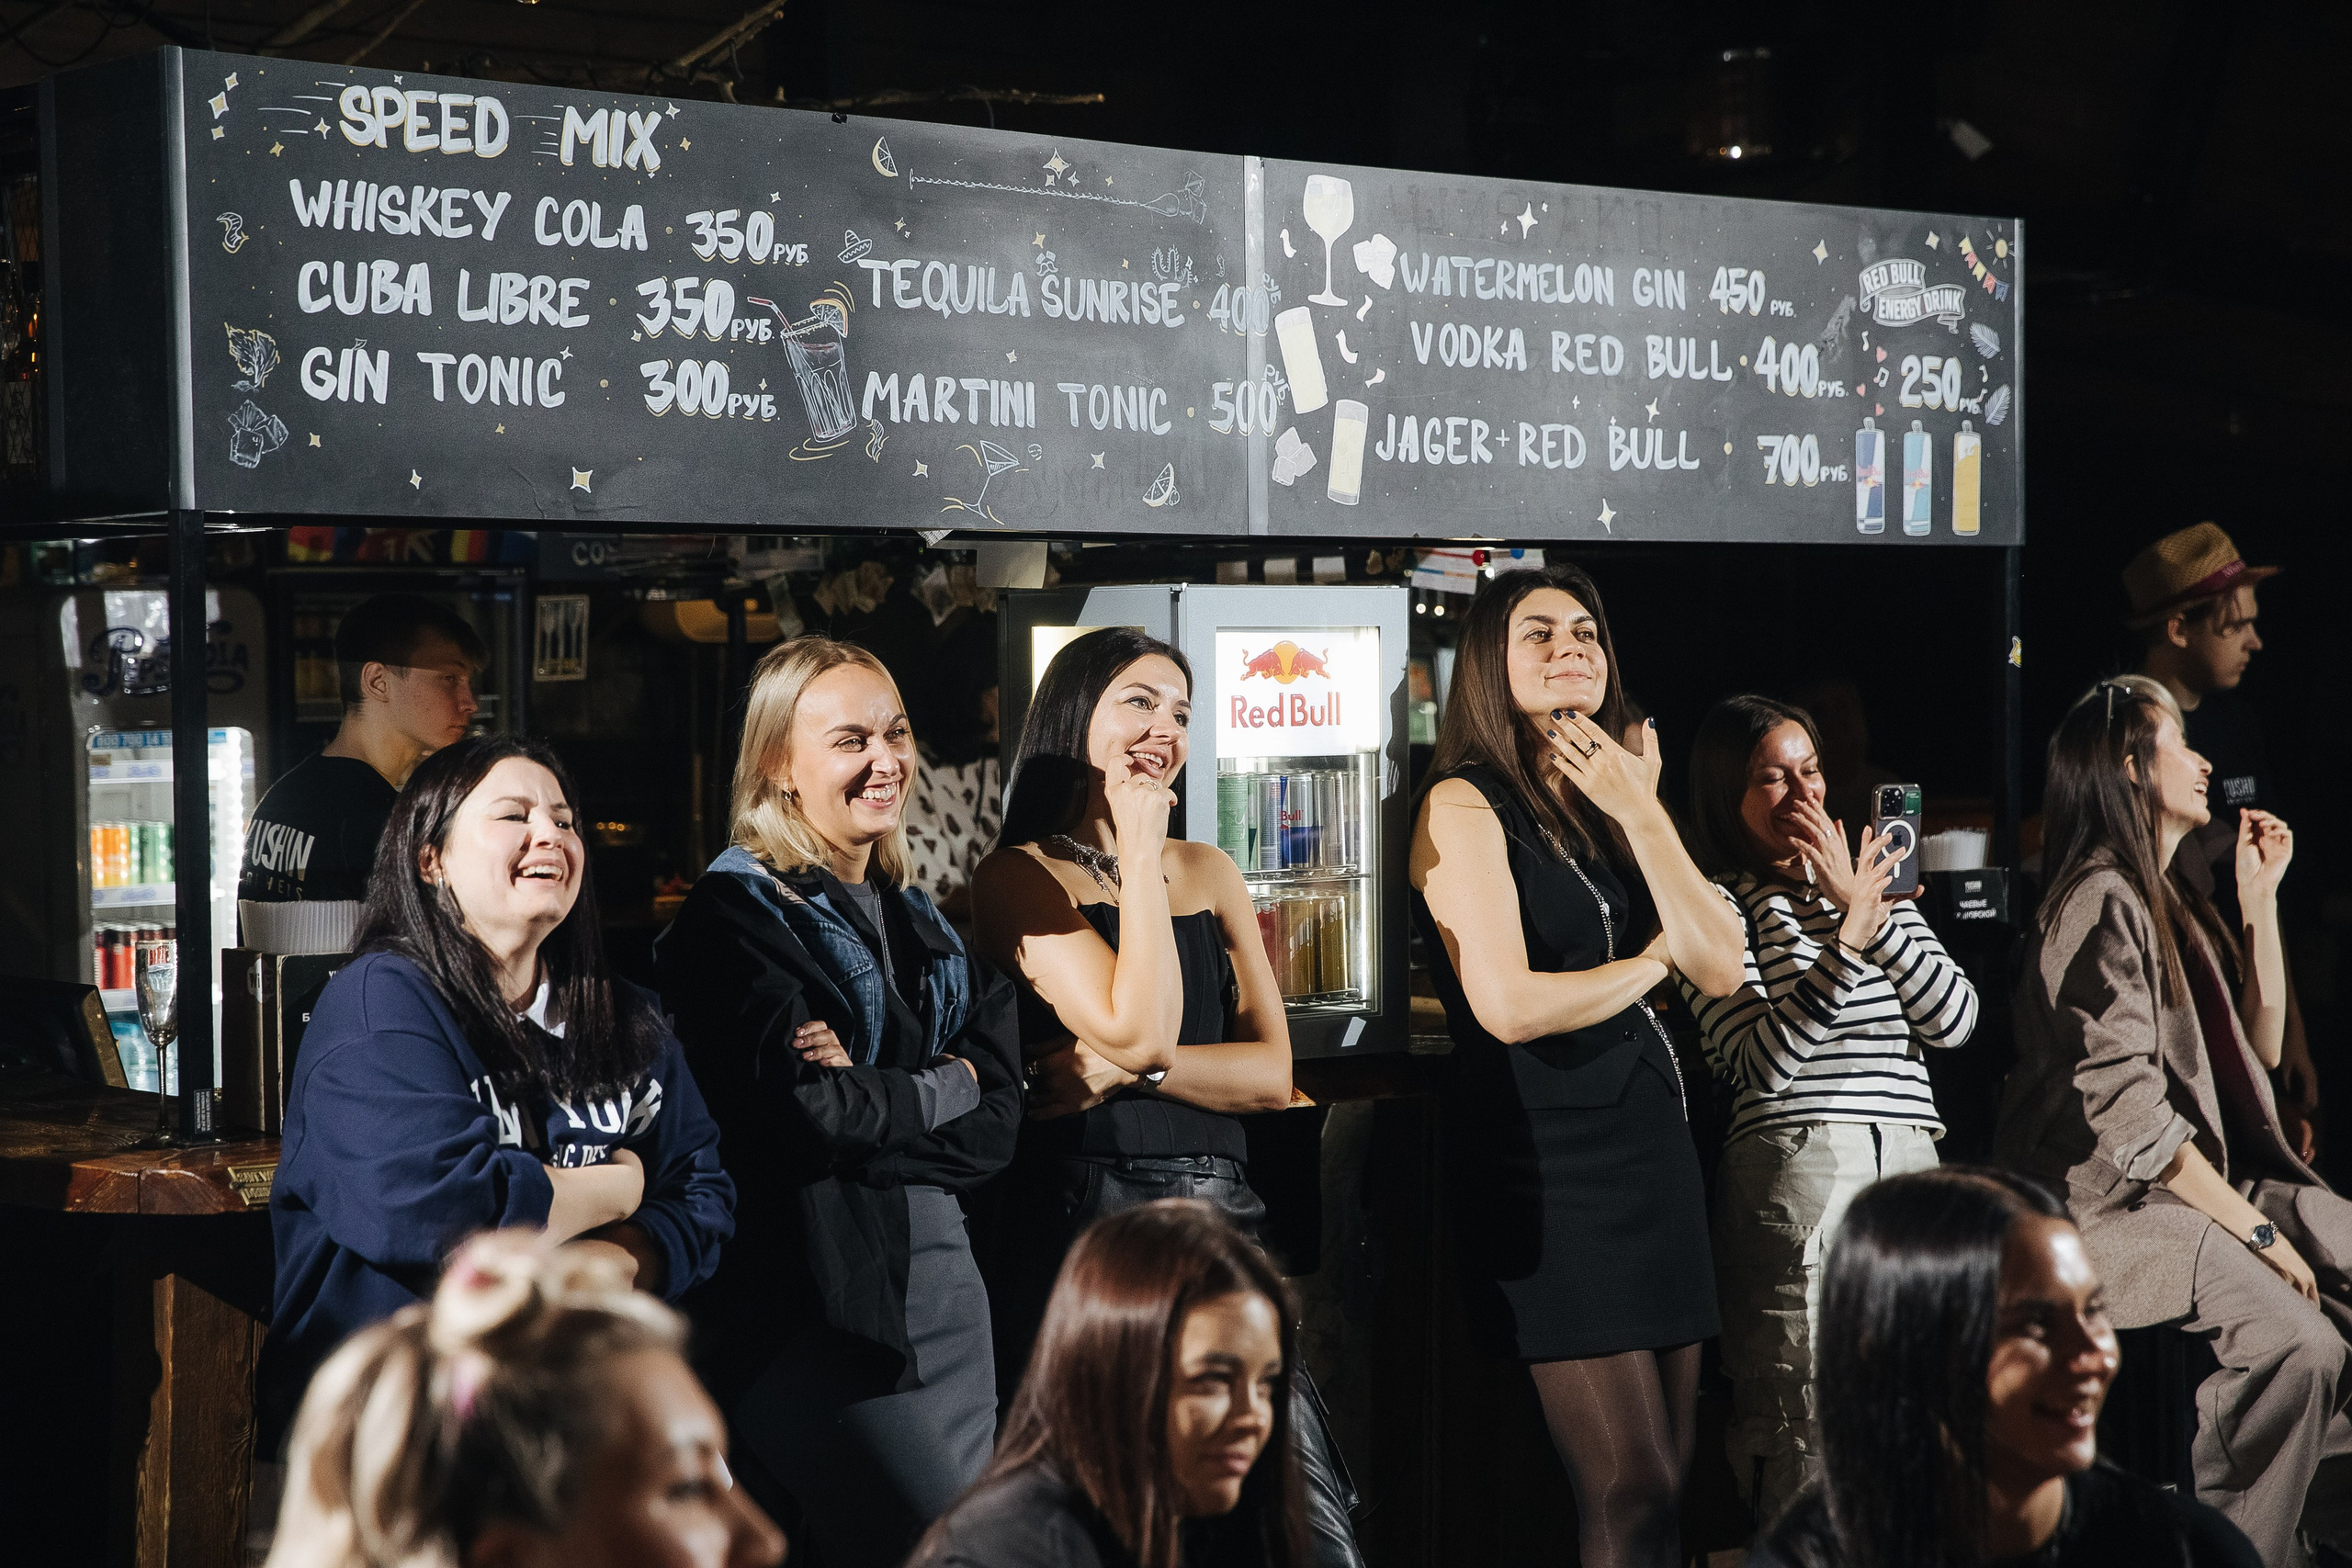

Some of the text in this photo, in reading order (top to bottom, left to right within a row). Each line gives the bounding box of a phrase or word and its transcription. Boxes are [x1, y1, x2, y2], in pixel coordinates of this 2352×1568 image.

[339, 85, 661, 172] SPEED MIX
[289, 179, 512, 242] WHISKEY
[534, 197, 649, 251] COLA
[685, 210, 775, 263] 350
[298, 260, 433, 316] CUBA
[459, 269, 591, 329] LIBRE
[637, 277, 736, 340] 350
[858, 259, 1031, 319] TEQUILA
[1041, 276, 1185, 328] SUNRISE
[1208, 283, 1270, 335] 400
[1399, 252, 1614, 305] WATERMELON
[1633, 266, 1686, 310] GIN
[1710, 265, 1765, 316] 450
[1861, 263, 1922, 295] RED BULL
[1878, 288, 1962, 321] ENERGY DRINK
[300, 344, 390, 405] GIN
[417, 352, 566, 409] TONIC
[640, 359, 729, 417] 300
[1410, 321, 1528, 371] VODKA
[1551, 333, 1624, 376] RED
[1646, 335, 1734, 381] BULL
[1753, 336, 1819, 397] 400
[1899, 355, 1962, 411] 250
[862, 371, 1035, 428] MARTINI
[1057, 382, 1172, 436] TONIC
[1208, 379, 1278, 436] 500
[1609, 424, 1700, 470] BULL
[1758, 434, 1819, 486] 700
[1230, 691, 1341, 728] Red Bull
